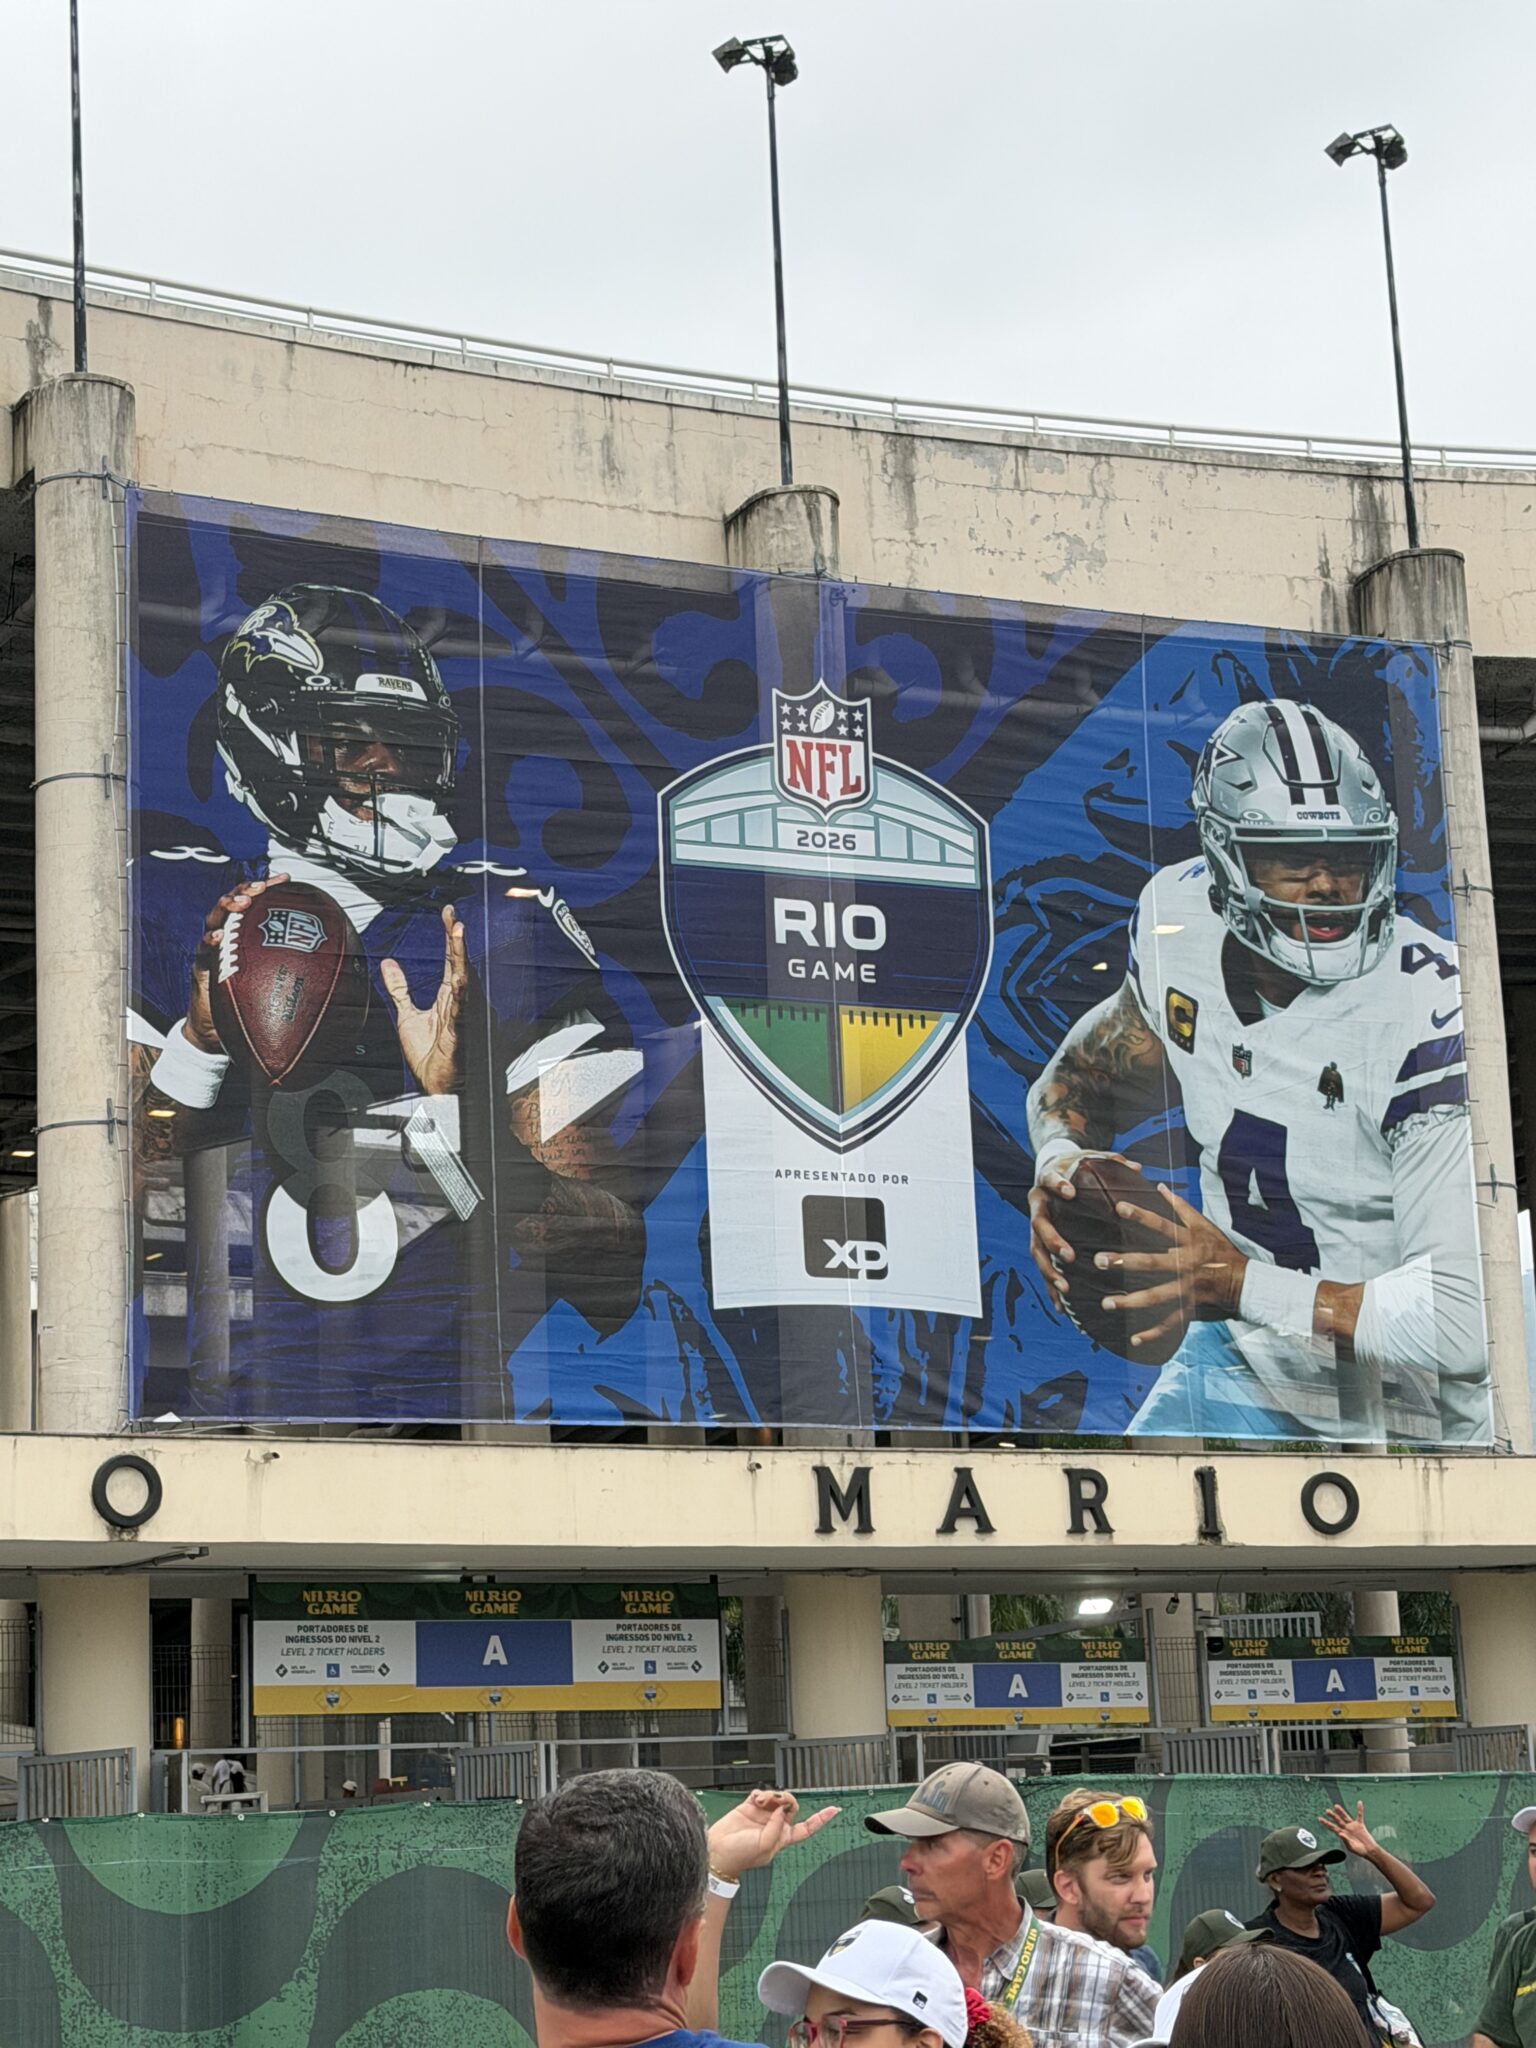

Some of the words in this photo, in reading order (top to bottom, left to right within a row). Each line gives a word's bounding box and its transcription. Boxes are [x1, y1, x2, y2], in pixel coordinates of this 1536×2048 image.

[377, 676, 414, 692] RAVENS
[785, 739, 863, 801] NFL
[1296, 811, 1341, 820] COWBOYS
[796, 829, 857, 851] 2026
[774, 897, 887, 951] RIO
[787, 958, 877, 984] GAME
[1168, 990, 1194, 1037] C
[774, 1168, 877, 1184] APRESENTADO
[882, 1174, 910, 1185] POR
[823, 1238, 889, 1276] XP
[813, 1465, 1361, 1538] MARIO
[307, 1603, 359, 1615] GAME
[469, 1602, 519, 1615] GAME
[624, 1602, 672, 1614] GAME
[297, 1624, 355, 1633] PORTADORES
[357, 1624, 369, 1633] DE
[616, 1623, 670, 1632] PORTADORES
[671, 1623, 682, 1632] DE
[285, 1635, 334, 1644] INGRESSOS
[335, 1635, 347, 1644] DO
[374, 1635, 381, 1643] 2
[605, 1633, 650, 1642] INGRESSOS
[651, 1633, 662, 1642] DO
[687, 1633, 693, 1641] 2
[280, 1647, 306, 1657] LEVEL
[308, 1647, 315, 1657] 2
[316, 1647, 346, 1656] TICKET
[346, 1646, 386, 1656] HOLDERS
[482, 1634, 509, 1666] A
[602, 1645, 626, 1654] LEVEL
[627, 1645, 633, 1654] 2
[634, 1645, 661, 1654] TICKET
[661, 1644, 698, 1653] HOLDERS
[999, 1650, 1034, 1659] GAME
[1085, 1650, 1121, 1659] GAME
[1232, 1647, 1268, 1656] GAME
[1315, 1646, 1350, 1655] GAME
[1395, 1645, 1428, 1654] GAME
[912, 1651, 949, 1660] GAME
[940, 1681, 969, 1689] HOLDERS
[1008, 1673, 1029, 1698] A
[1325, 1668, 1346, 1693] A
[1020, 1941, 1037, 1964] RIO
[1005, 1965, 1027, 2000] GAME
